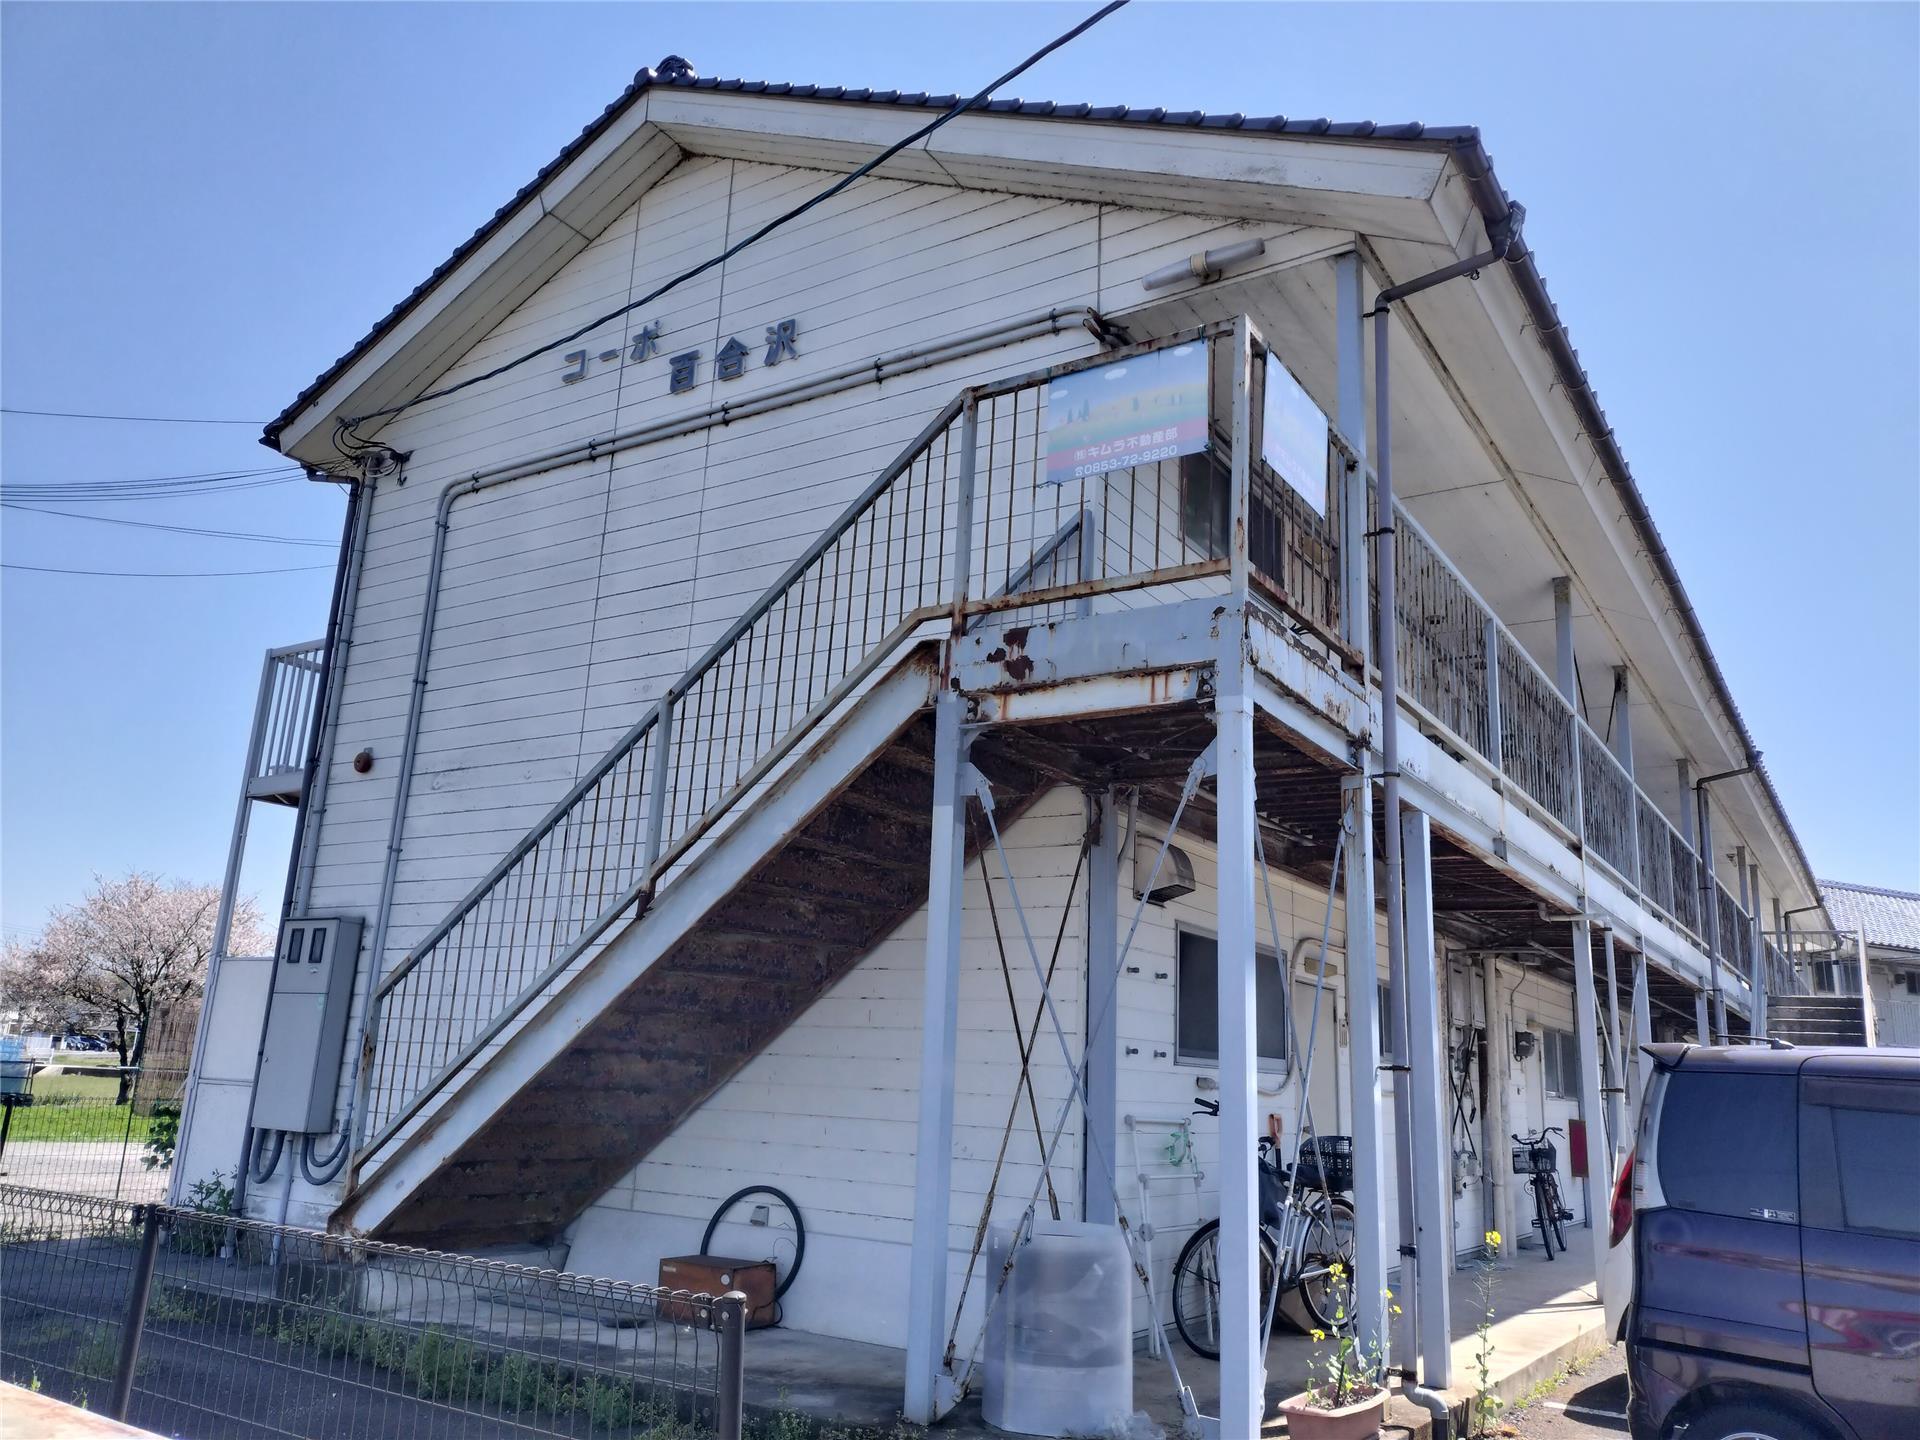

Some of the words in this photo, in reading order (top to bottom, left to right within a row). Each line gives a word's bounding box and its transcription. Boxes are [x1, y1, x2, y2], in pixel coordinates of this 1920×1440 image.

[562, 320, 662, 384] コーポ
[669, 318, 798, 394] 百合沢
